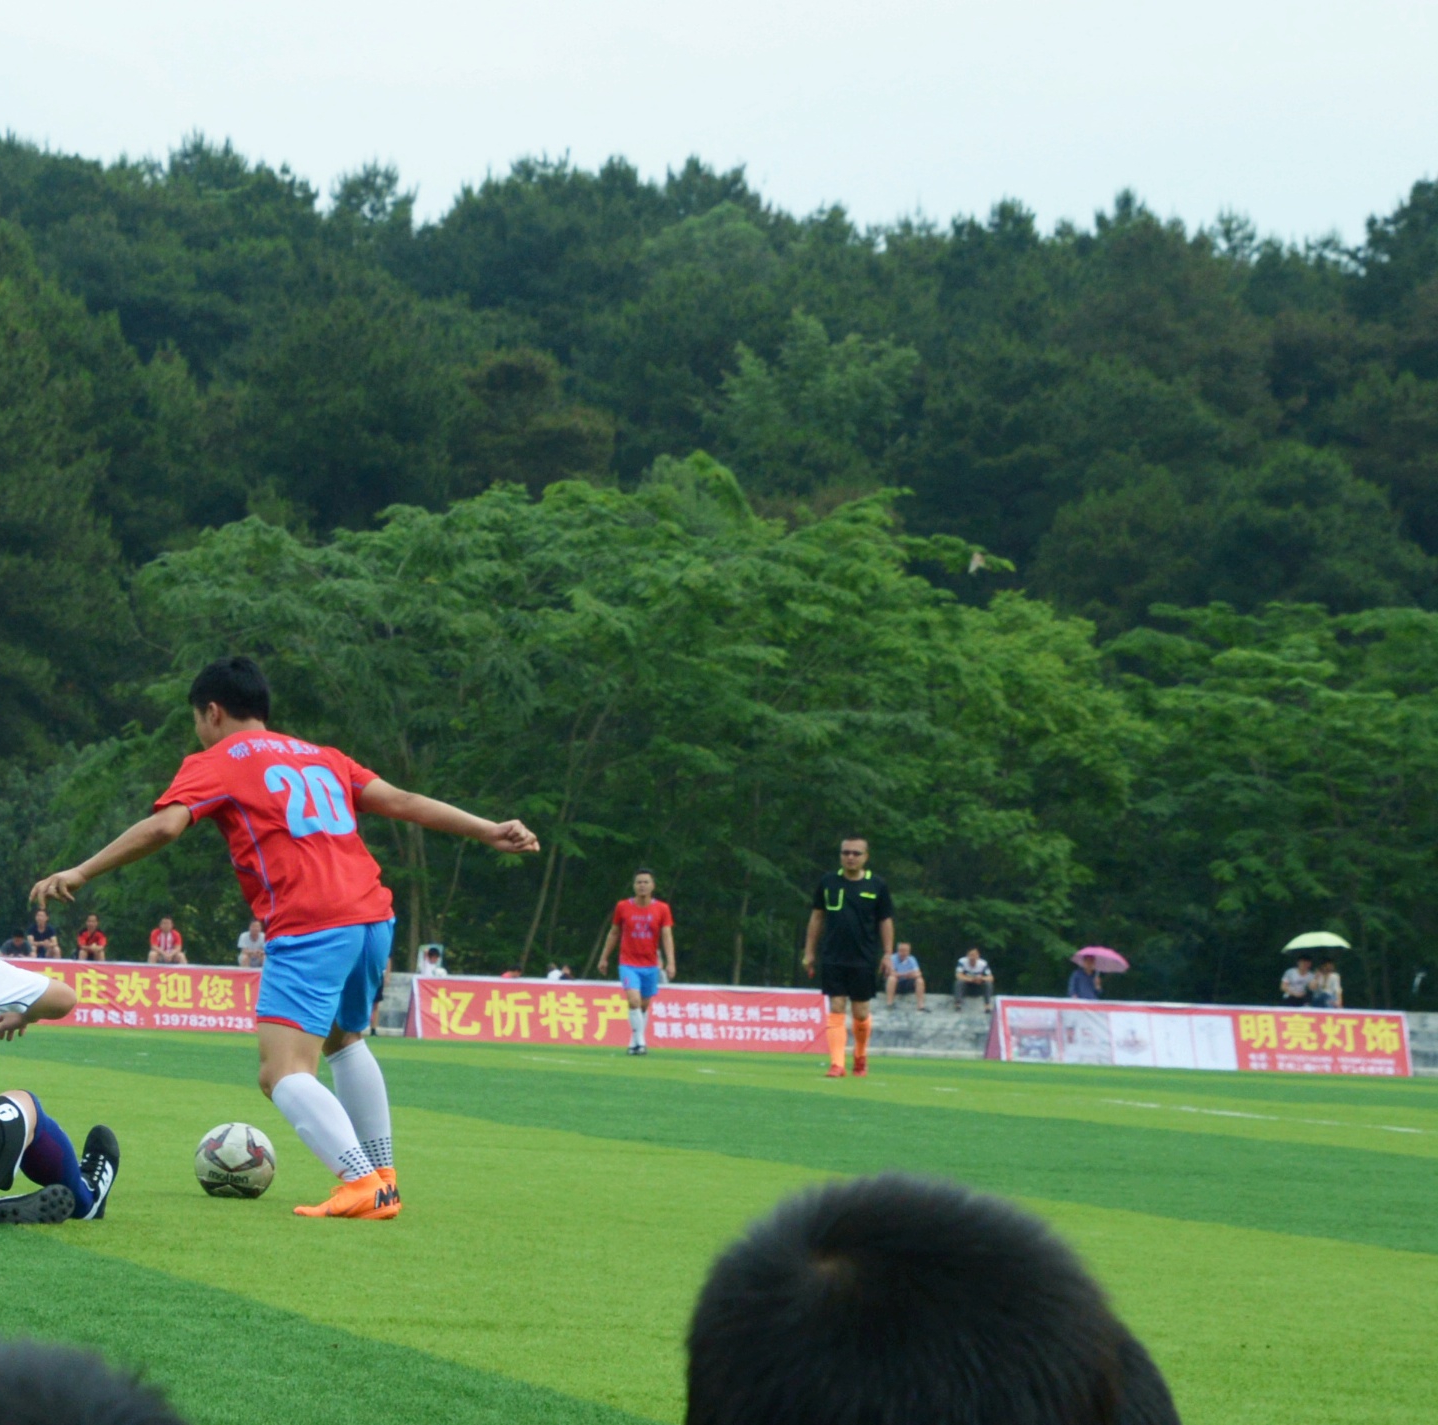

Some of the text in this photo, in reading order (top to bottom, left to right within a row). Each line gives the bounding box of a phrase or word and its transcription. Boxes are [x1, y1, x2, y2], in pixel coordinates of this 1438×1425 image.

[264, 764, 357, 838] 20
[431, 987, 629, 1041] 忆忻特产
[1238, 1014, 1401, 1054] 明亮灯饰
[208, 1170, 249, 1184] molten
